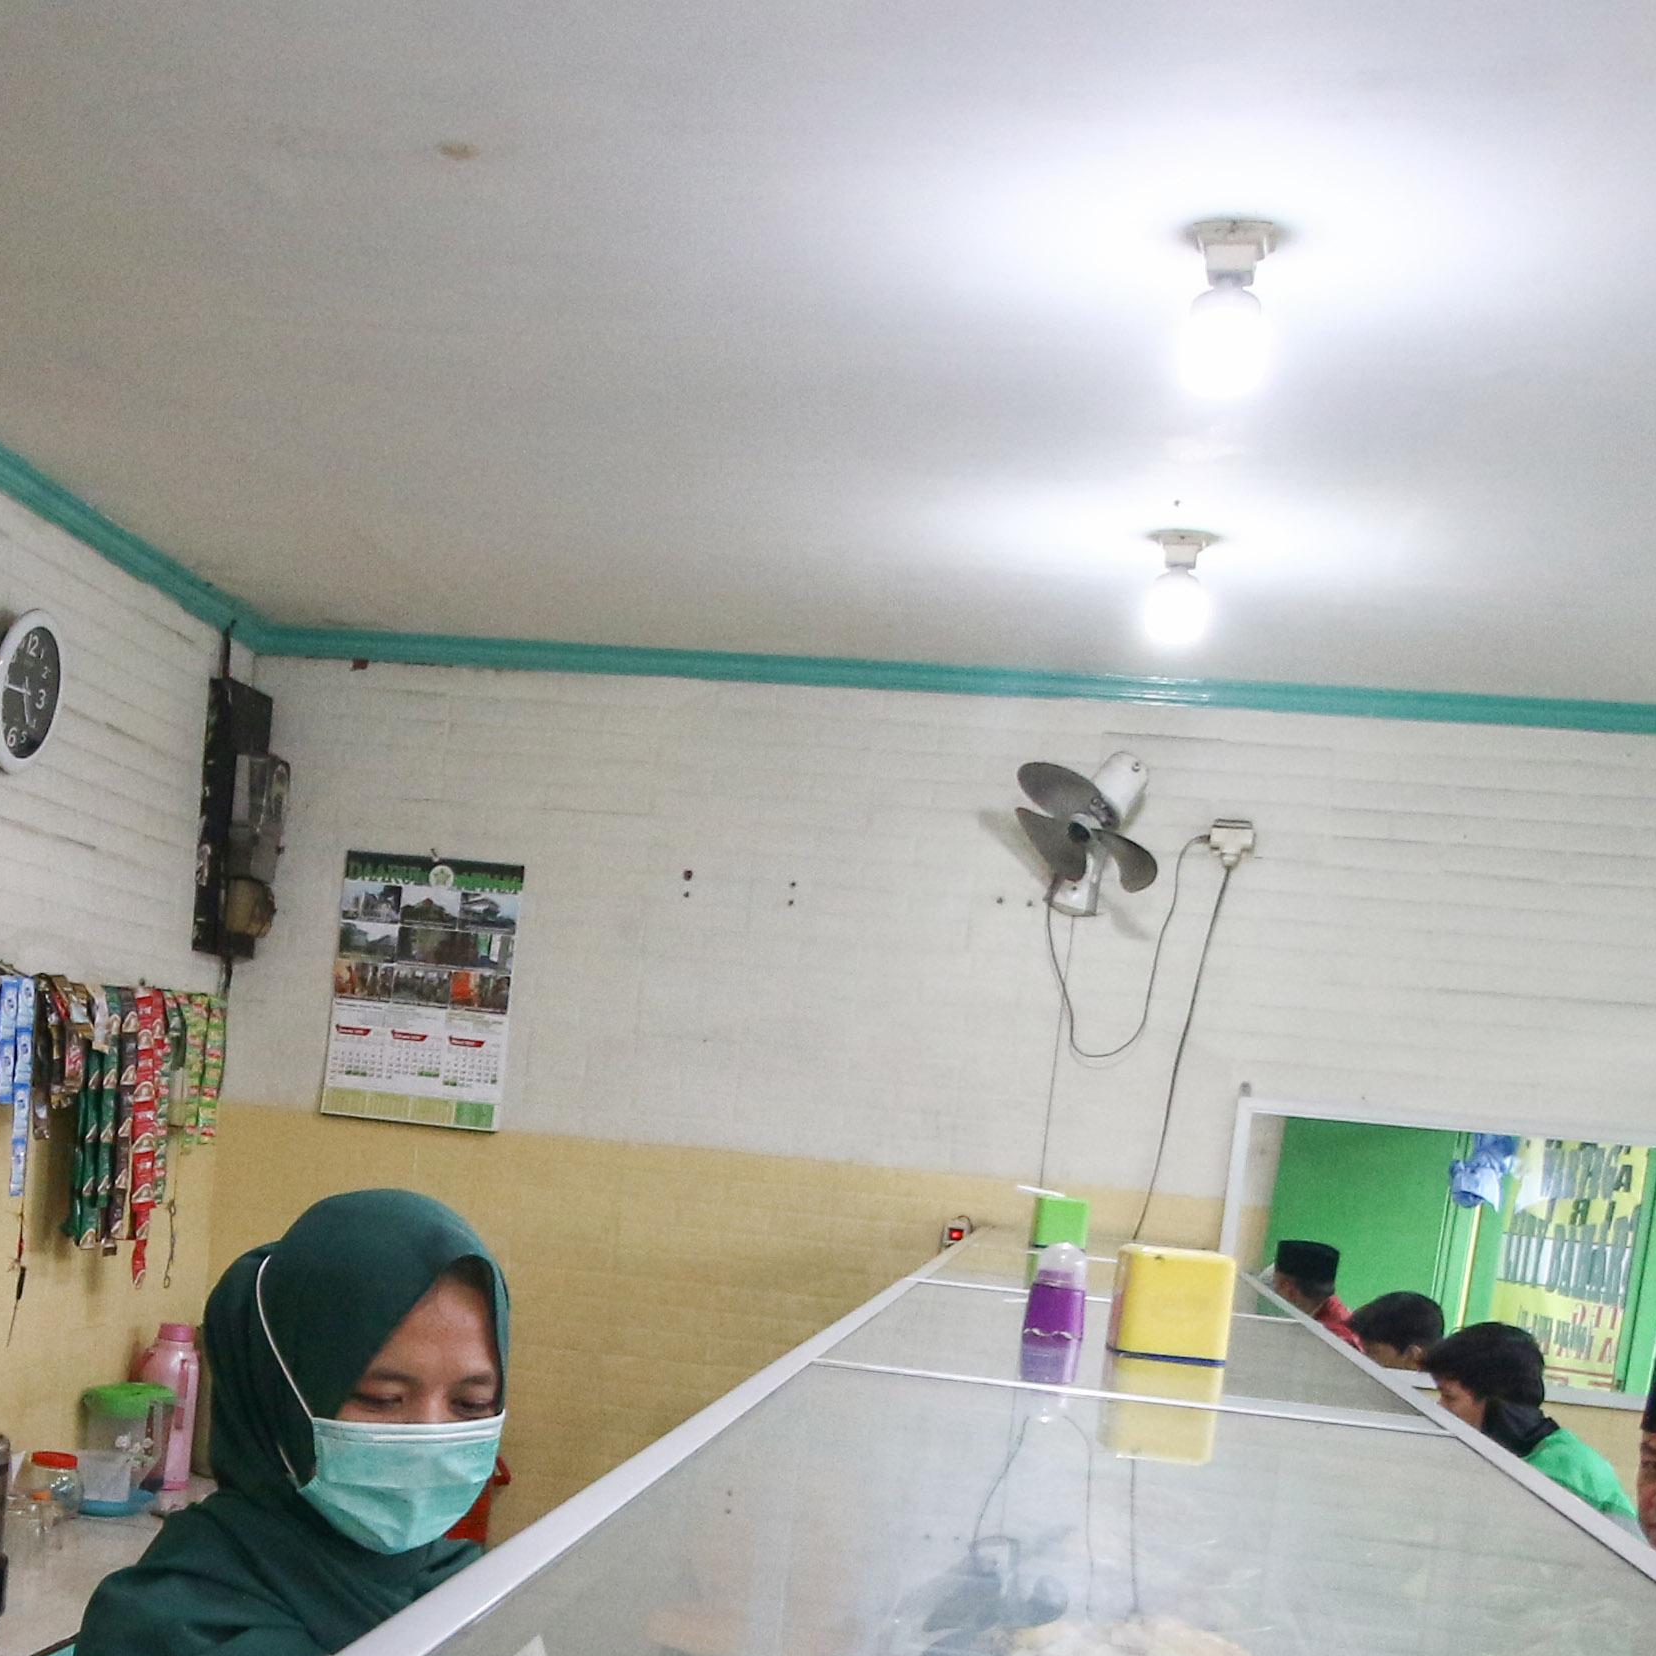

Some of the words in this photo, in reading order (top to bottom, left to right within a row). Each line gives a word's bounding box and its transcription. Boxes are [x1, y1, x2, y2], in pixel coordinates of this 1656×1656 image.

[27, 633, 39, 658] 12
[35, 688, 47, 710] 3
[6, 727, 17, 748] 6
